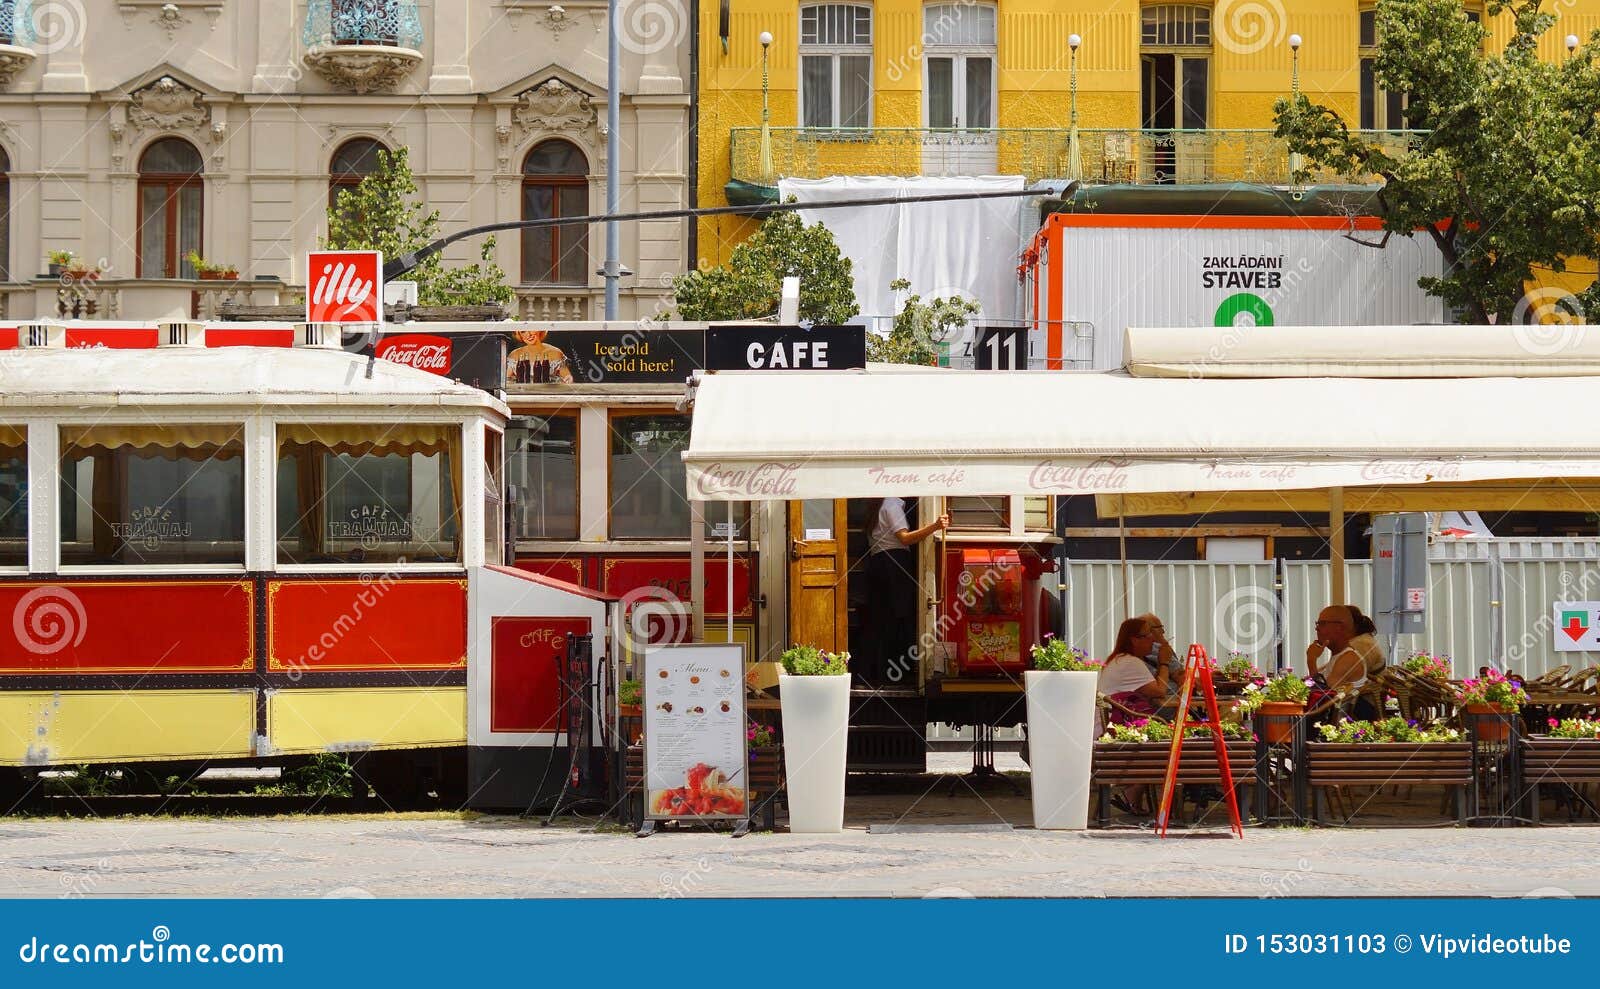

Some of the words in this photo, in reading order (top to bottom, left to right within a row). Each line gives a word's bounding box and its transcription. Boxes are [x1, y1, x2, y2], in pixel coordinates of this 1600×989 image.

[1202, 254, 1285, 269] ZAKLÁDÁNÍ
[313, 262, 373, 315] illy
[1202, 271, 1282, 289] STAVEB
[594, 342, 616, 356] Ice
[619, 342, 649, 356] cold
[746, 341, 829, 369] CAFE
[986, 331, 1016, 370] 11
[606, 358, 636, 372] sold
[639, 358, 675, 372] here!
[868, 464, 921, 485] Tram
[1200, 463, 1252, 479] Tram
[350, 504, 391, 520] CAFE
[328, 516, 412, 537] TRAMVAJ
